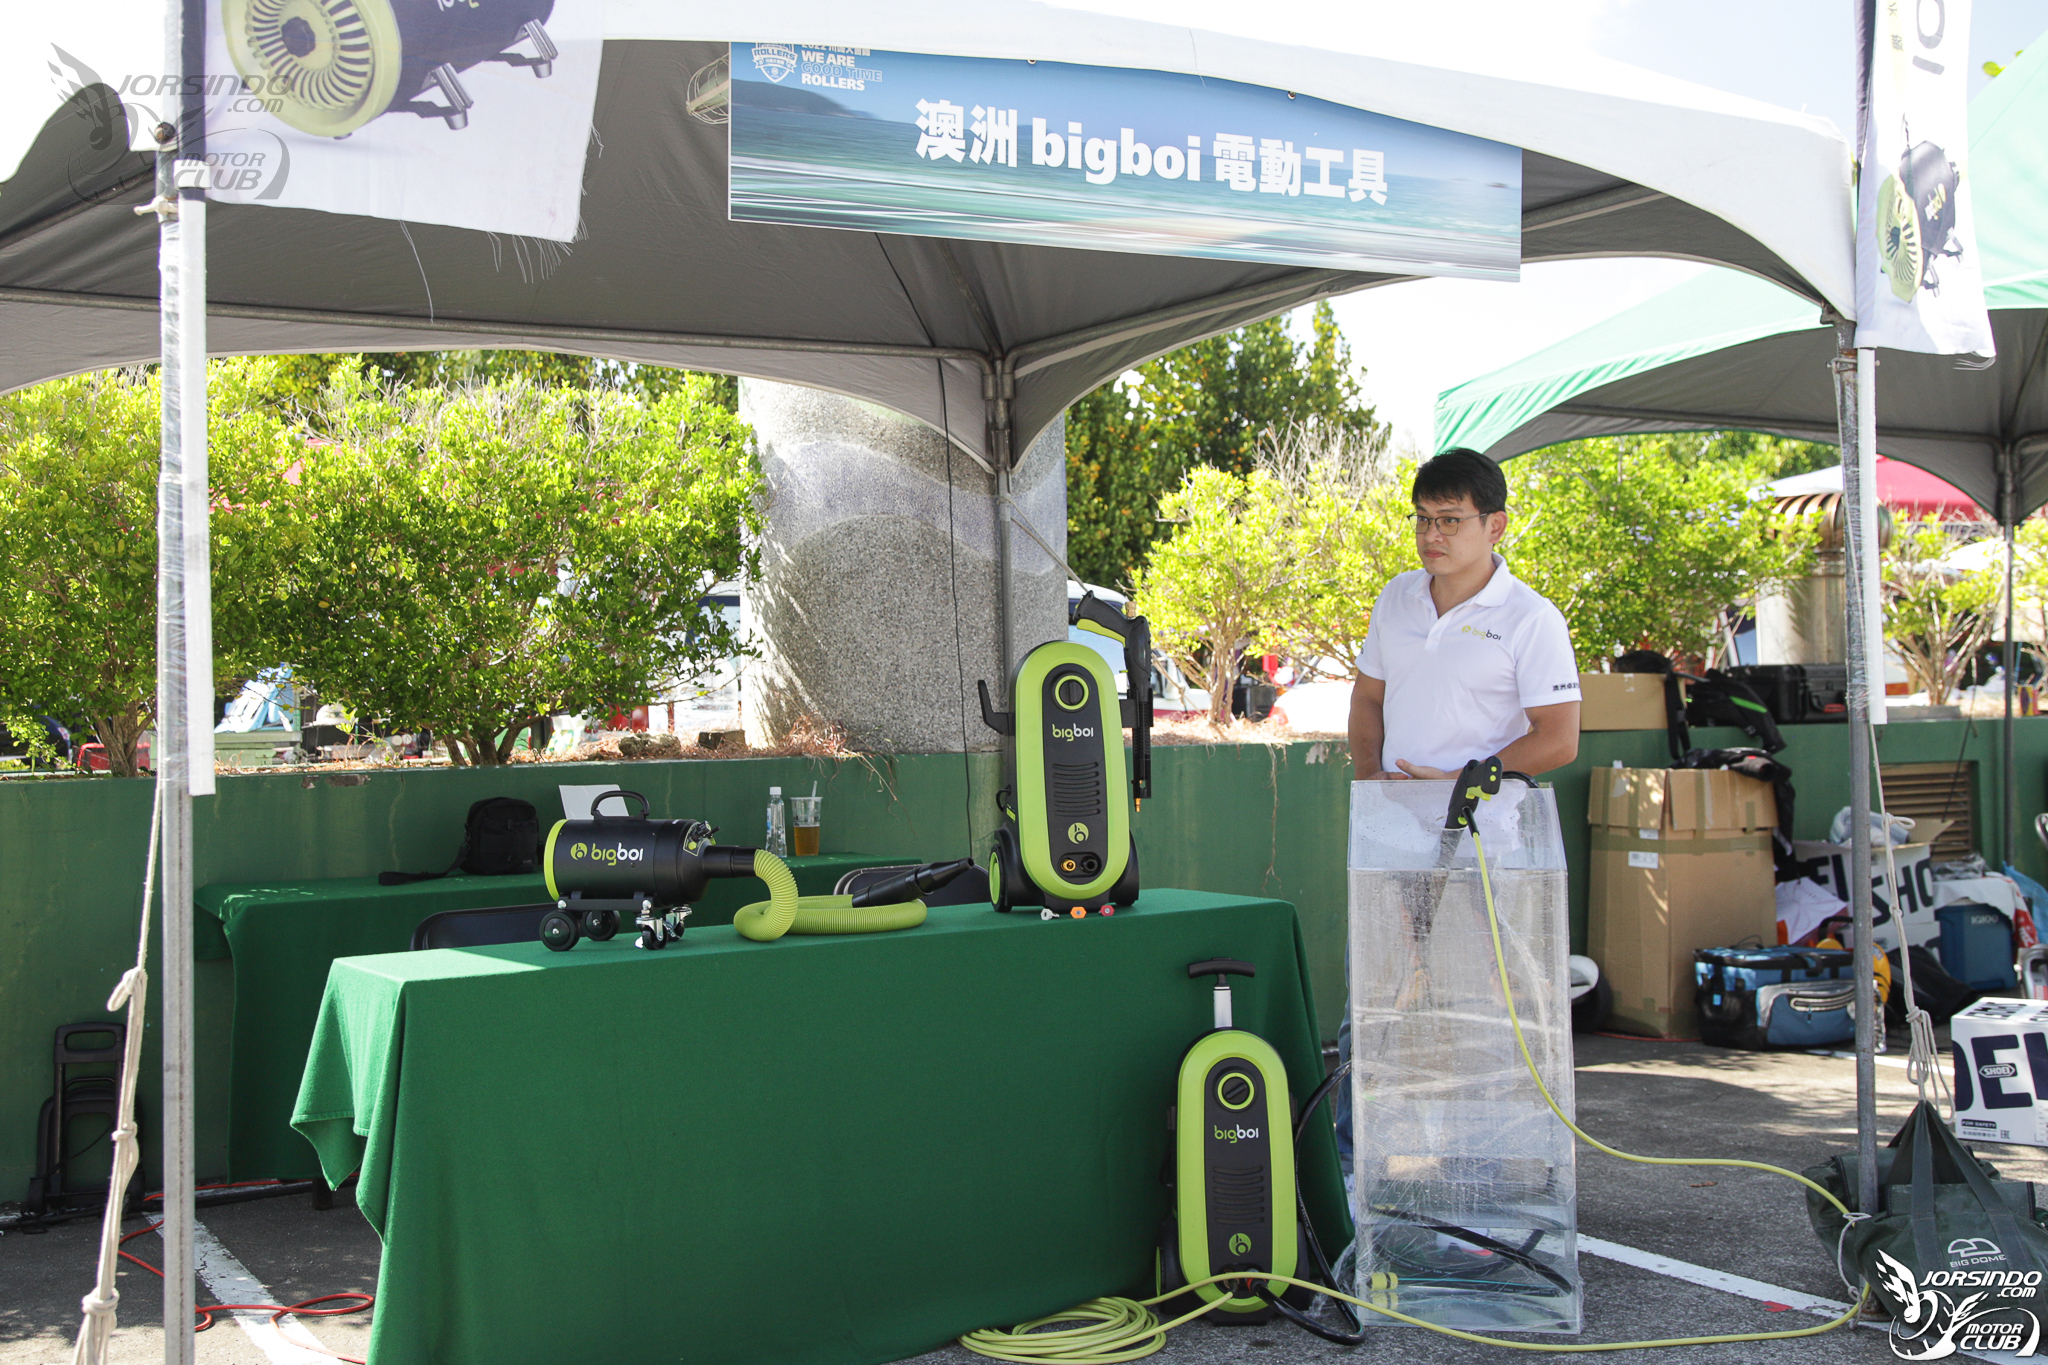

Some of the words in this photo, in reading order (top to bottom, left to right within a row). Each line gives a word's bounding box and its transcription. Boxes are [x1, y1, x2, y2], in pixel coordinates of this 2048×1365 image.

[753, 48, 796, 61] ROLLERS
[801, 49, 825, 63] WE
[826, 53, 856, 67] ARE
[801, 61, 843, 77] GOOD
[846, 67, 883, 82] TIME
[801, 73, 865, 91] ROLLERS
[915, 97, 1018, 168] 澳洲
[1031, 116, 1201, 185] bigboi
[1212, 132, 1388, 206] 電動工具
[1051, 722, 1094, 742] bigboi
[590, 842, 644, 866] bigboi
[1983, 1066, 2011, 1077] SHOEI
[1213, 1123, 1260, 1144] bigboi
[1949, 1259, 1970, 1268] BIG
[1970, 1254, 2007, 1265] DOME
